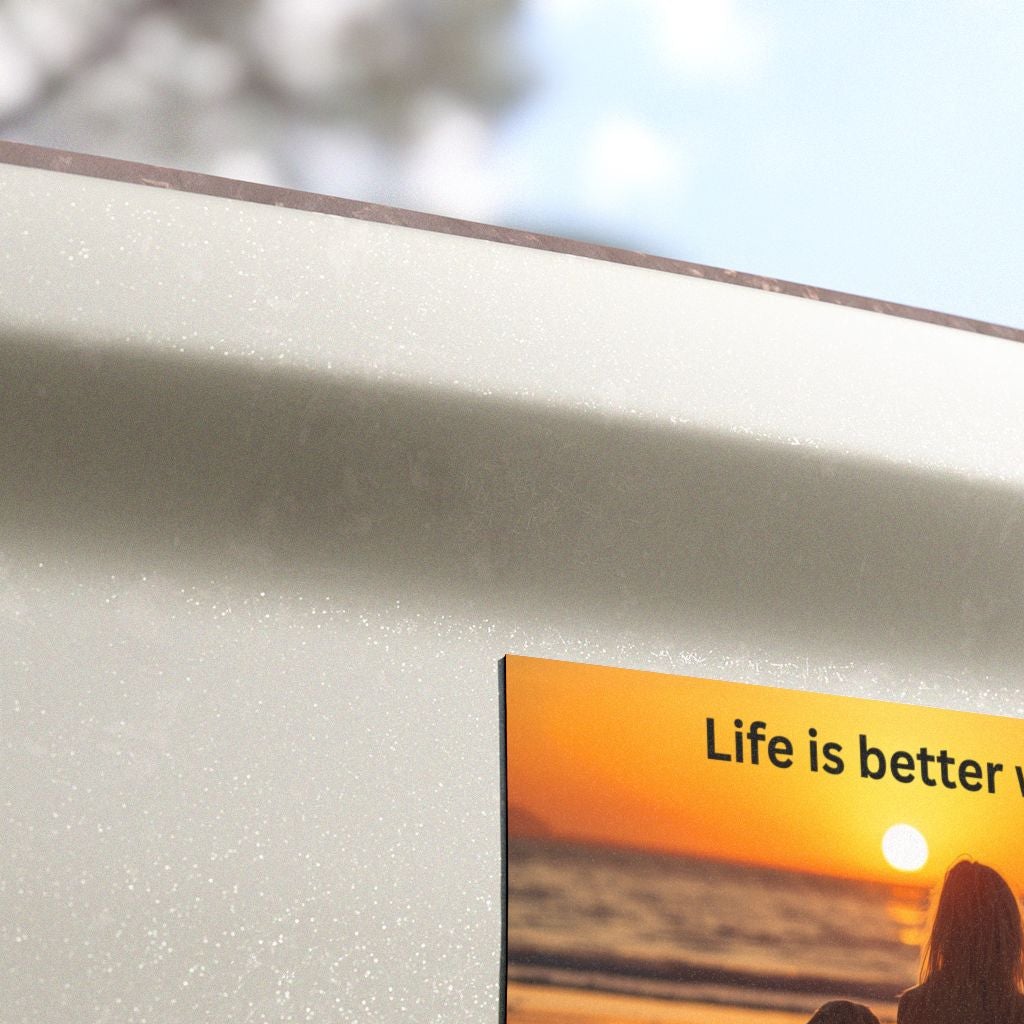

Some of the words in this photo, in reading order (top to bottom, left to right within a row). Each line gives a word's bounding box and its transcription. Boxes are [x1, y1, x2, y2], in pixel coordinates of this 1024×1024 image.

[705, 717, 794, 770] Life
[807, 727, 846, 776] is
[858, 733, 1004, 795] better
